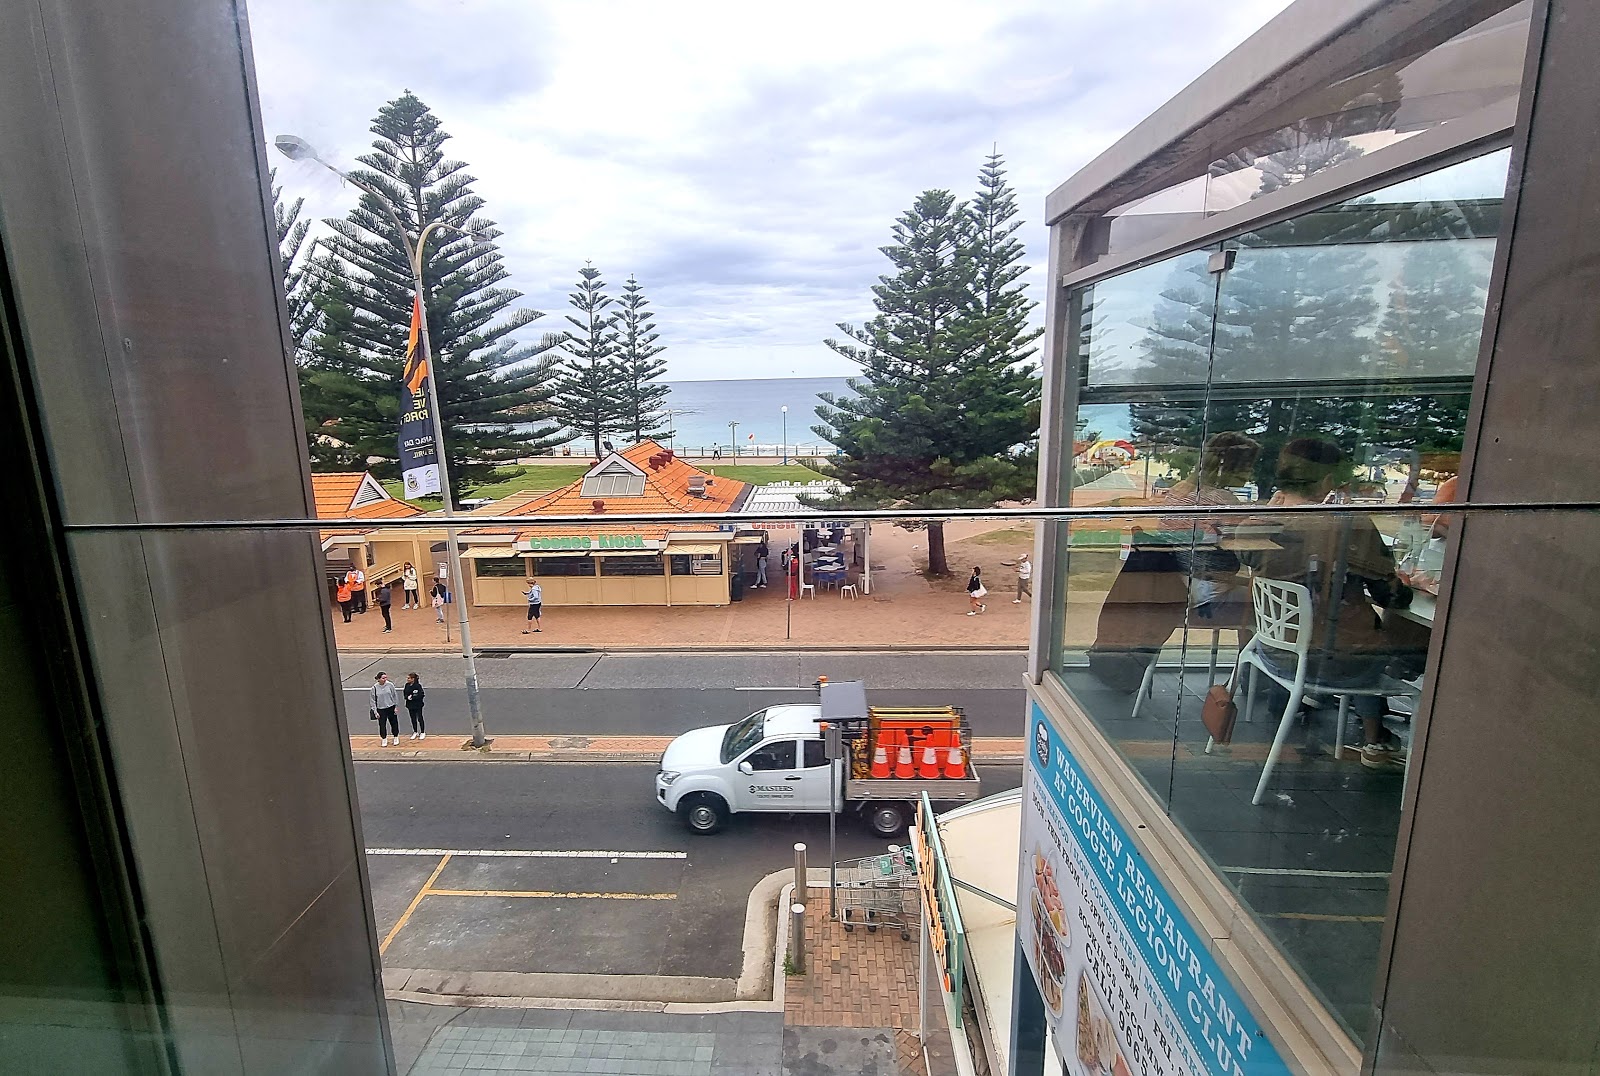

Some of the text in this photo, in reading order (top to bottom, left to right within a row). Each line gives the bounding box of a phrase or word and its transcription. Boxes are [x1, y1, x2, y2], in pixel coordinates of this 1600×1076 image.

[1032, 791, 1045, 819] MON
[1062, 847, 1080, 887] FROM
[1106, 932, 1112, 949] &
[1113, 945, 1139, 1000] 5-9PM
[1152, 1018, 1175, 1071] FRI,
[1054, 771, 1067, 799] AT
[1068, 794, 1115, 882] COOGEE
[1116, 872, 1183, 993] LEGION
[1056, 746, 1252, 1061] WATERVIEW RESTAURANT
[1073, 848, 1089, 879] SLOW
[1090, 879, 1118, 933] COOKED
[1119, 930, 1137, 968] RIBS
[1078, 906, 1117, 988] BOOKINGS
[1085, 942, 1149, 1076] CALL 9665
